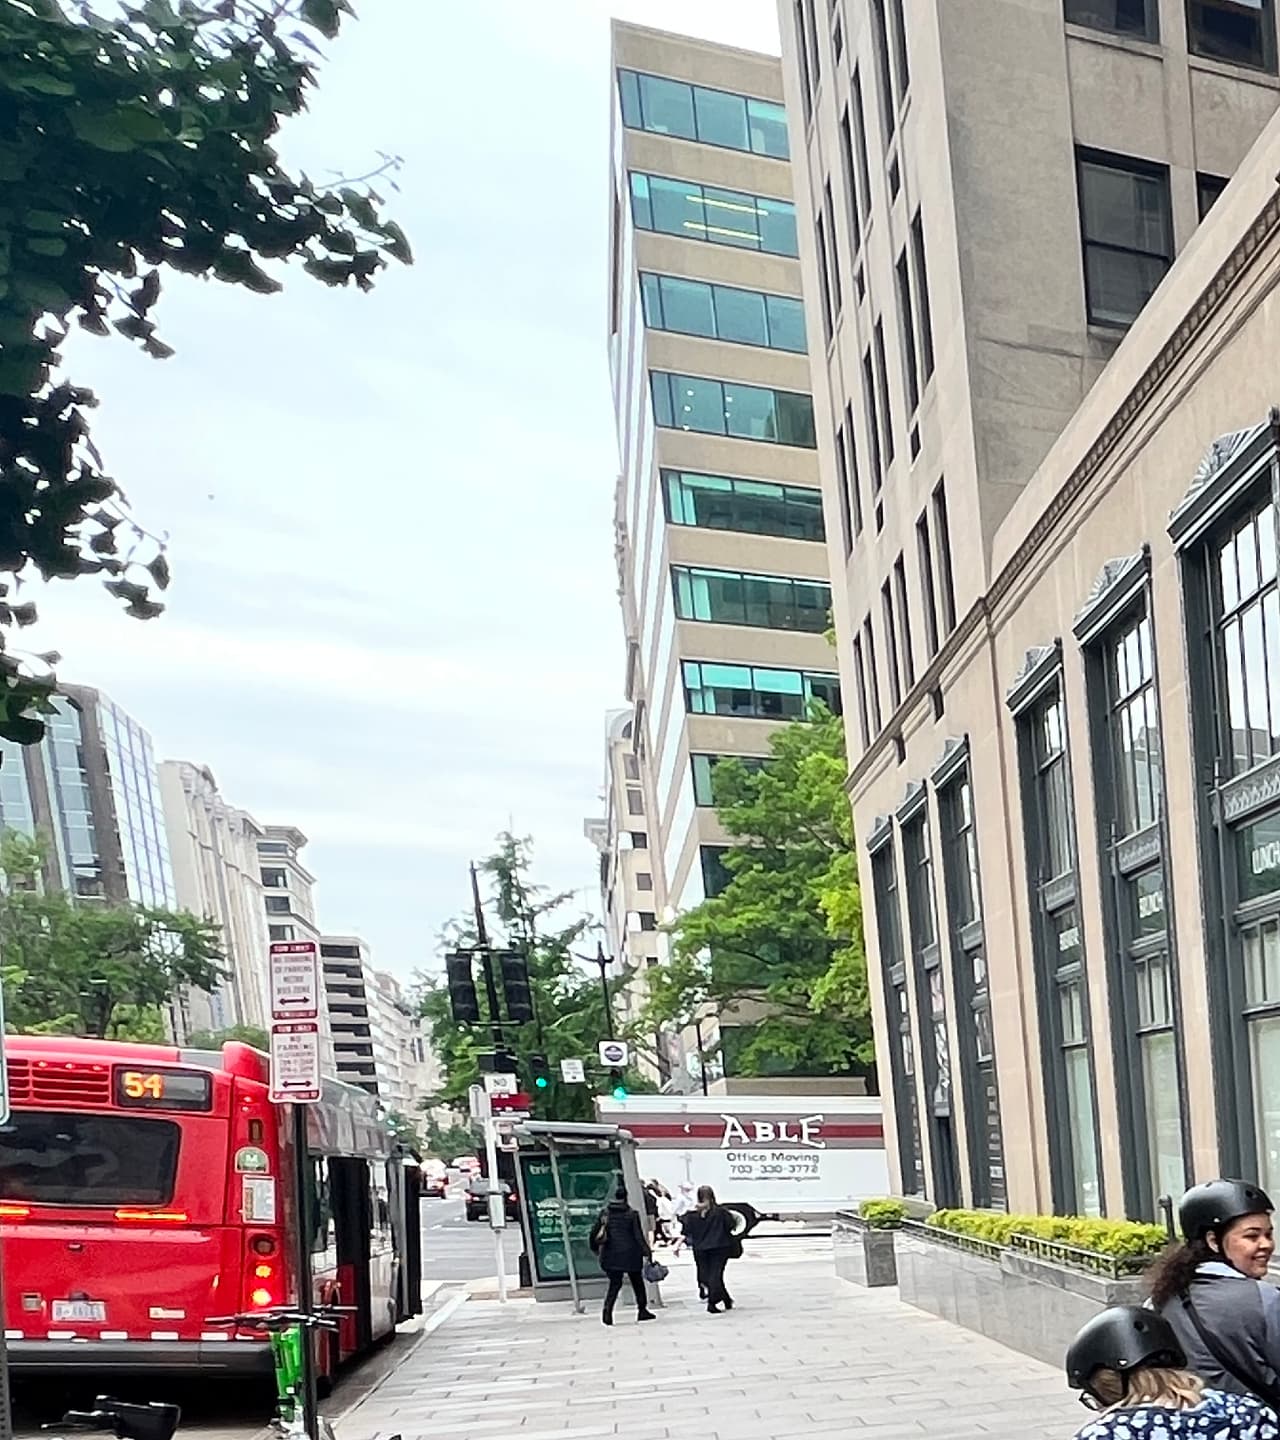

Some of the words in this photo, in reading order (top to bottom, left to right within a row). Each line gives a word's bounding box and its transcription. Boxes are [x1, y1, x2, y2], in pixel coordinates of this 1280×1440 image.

[122, 1072, 163, 1098] 54
[720, 1113, 826, 1149] ABLE
[770, 1152, 820, 1164] Moving
